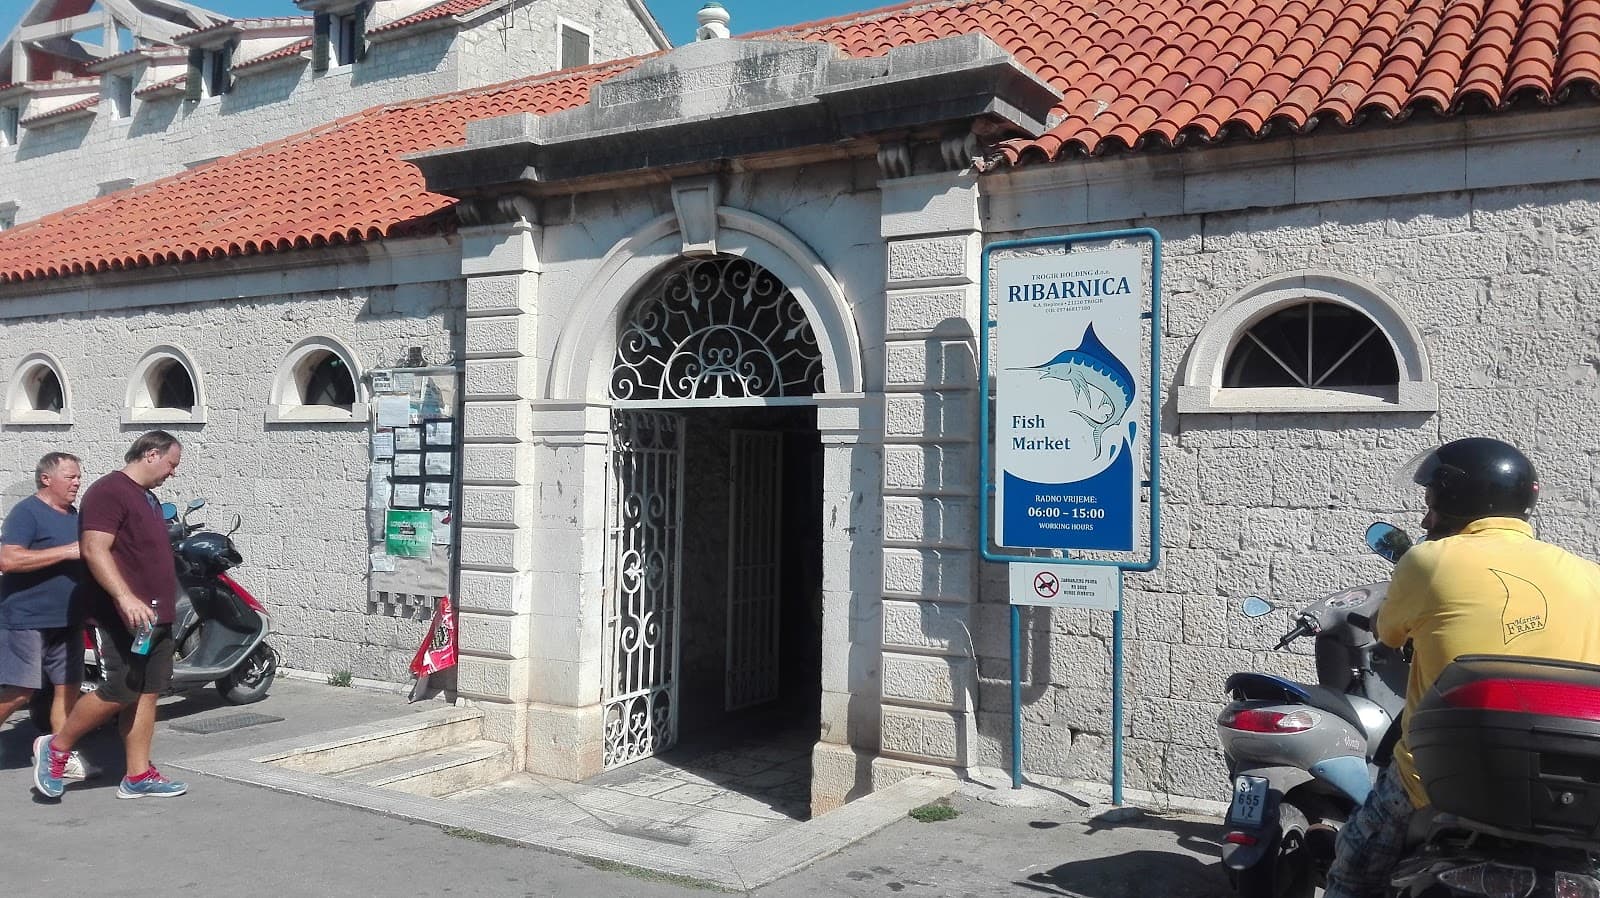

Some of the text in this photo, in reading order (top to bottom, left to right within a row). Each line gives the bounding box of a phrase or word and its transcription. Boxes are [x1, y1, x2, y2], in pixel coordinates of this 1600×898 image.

[1060, 270, 1093, 278] HOLDING
[1008, 276, 1131, 302] RIBARNICA
[1012, 415, 1045, 428] Fish
[1012, 437, 1070, 450] Market
[1035, 494, 1098, 504] RADNO VRIJEME:
[1028, 506, 1060, 518] 06:00
[1072, 508, 1105, 519] 15:00
[1039, 522, 1094, 531] WORKING HOURS
[1514, 615, 1541, 626] Marina
[1506, 621, 1544, 635] FRAPA
[1238, 793, 1260, 806] 655
